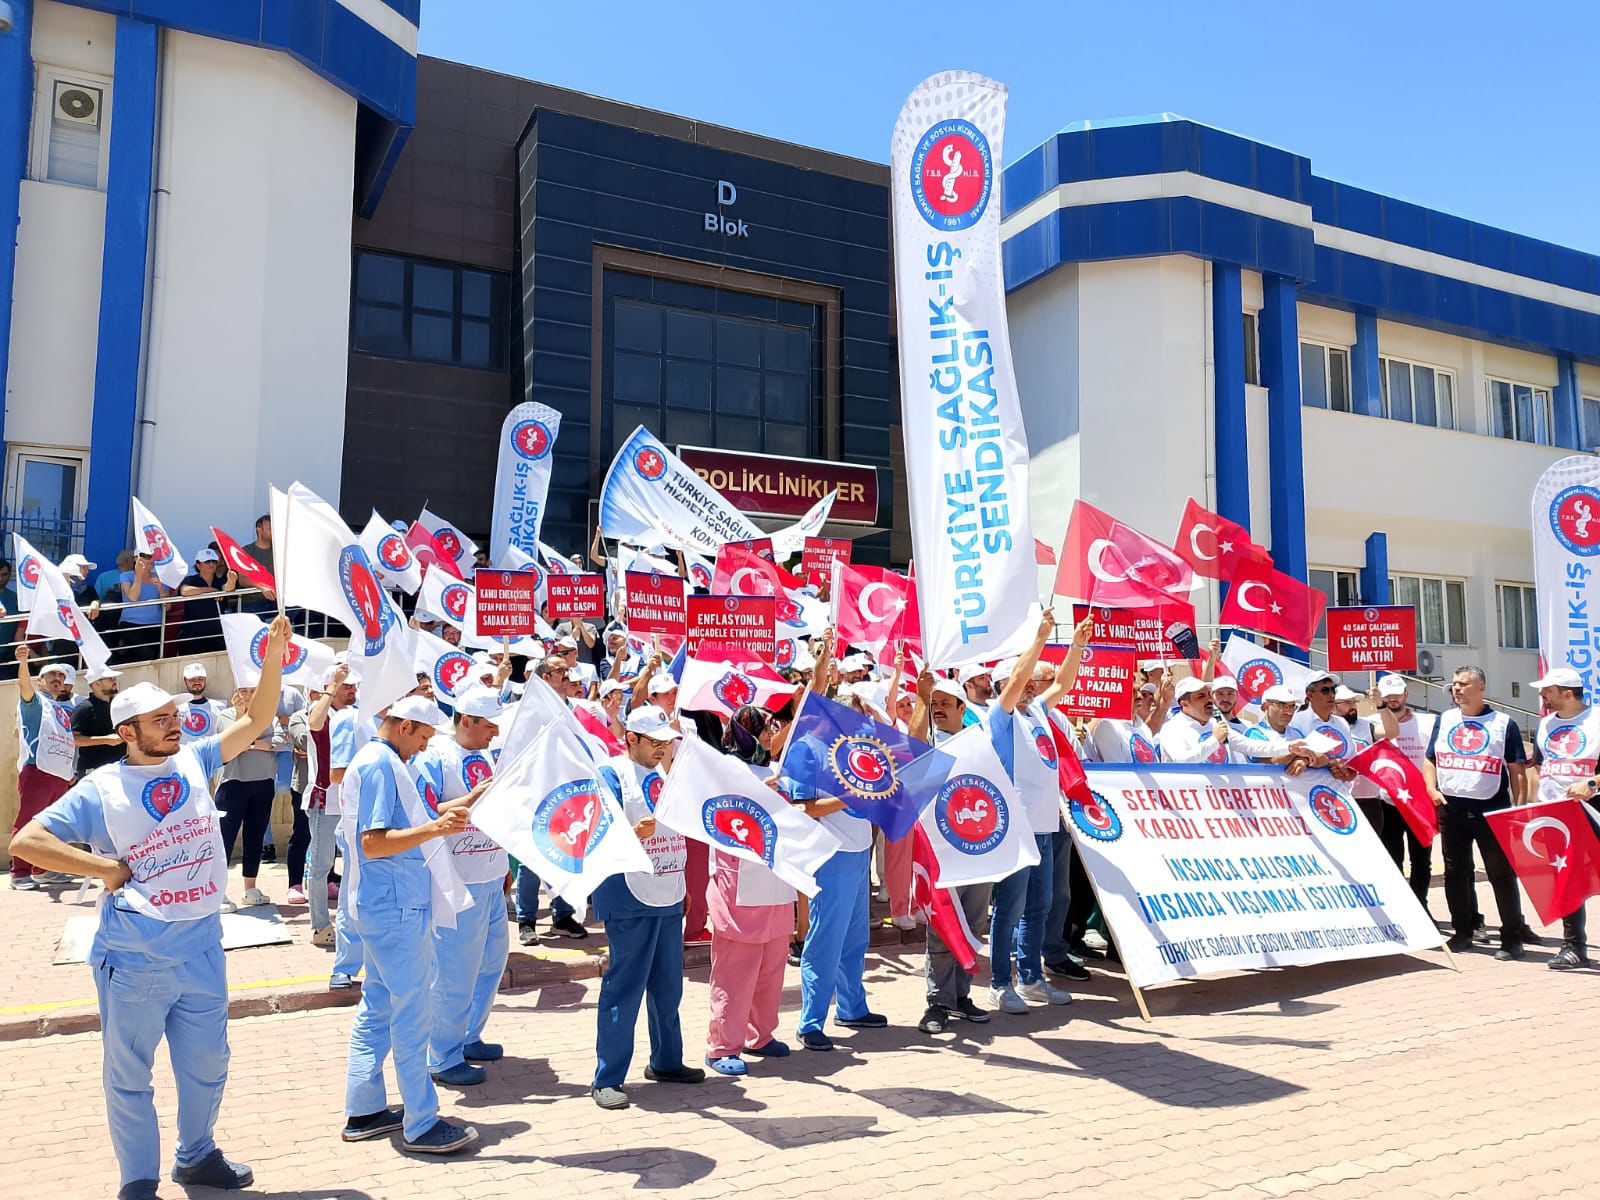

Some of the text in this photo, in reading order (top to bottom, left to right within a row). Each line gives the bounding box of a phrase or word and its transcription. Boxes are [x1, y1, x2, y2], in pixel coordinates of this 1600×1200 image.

[922, 140, 931, 151] VE
[930, 125, 956, 142] SOSYAL
[718, 179, 737, 206] D
[704, 212, 749, 238] Blok
[925, 241, 989, 645] TÜRKİYE SAĞLIK-İŞ
[963, 330, 1013, 555] SENDİKASI
[672, 471, 719, 515] TÜRKİYE
[689, 525, 720, 551] KONY
[552, 584, 599, 596] GREV YASAĞI
[630, 590, 681, 608] SAĞLIKTA GREV
[556, 602, 572, 612] HAK
[482, 614, 510, 626] SADAKA
[697, 614, 765, 626] ENFLASYONLA
[1094, 623, 1106, 638] DE
[688, 627, 728, 639] MÜCADELE
[1340, 633, 1404, 649] LÜKS DEĞİL,
[1352, 650, 1394, 663] HAKTIR!
[1078, 663, 1096, 677] ÖRE
[1098, 664, 1129, 680] DEĞİL!
[1086, 680, 1123, 694] PAZARA
[1078, 694, 1111, 709] ÜCRET!
[940, 778, 967, 802] TÜRKİYE
[1122, 788, 1203, 812] SEFALET
[1205, 784, 1293, 811] ÜCRETİNİ
[716, 800, 745, 809] AĞLIK
[130, 814, 212, 852] Sğlık ve Sosy
[1134, 814, 1313, 840] KABUL ETMİYORUZ
[1162, 854, 1244, 882] İNSANCA
[1136, 882, 1385, 924] İNSANCA YAŞAMAK İSTİYORUZ
[1156, 937, 1211, 966] TÜRKİYE
[1207, 934, 1247, 958] SAĞLIK
[1244, 934, 1261, 954] VE
[1256, 931, 1291, 954] SOSYAL
[1292, 928, 1327, 951] HİZMET
[1323, 926, 1362, 951] İŞÇİLERİ
